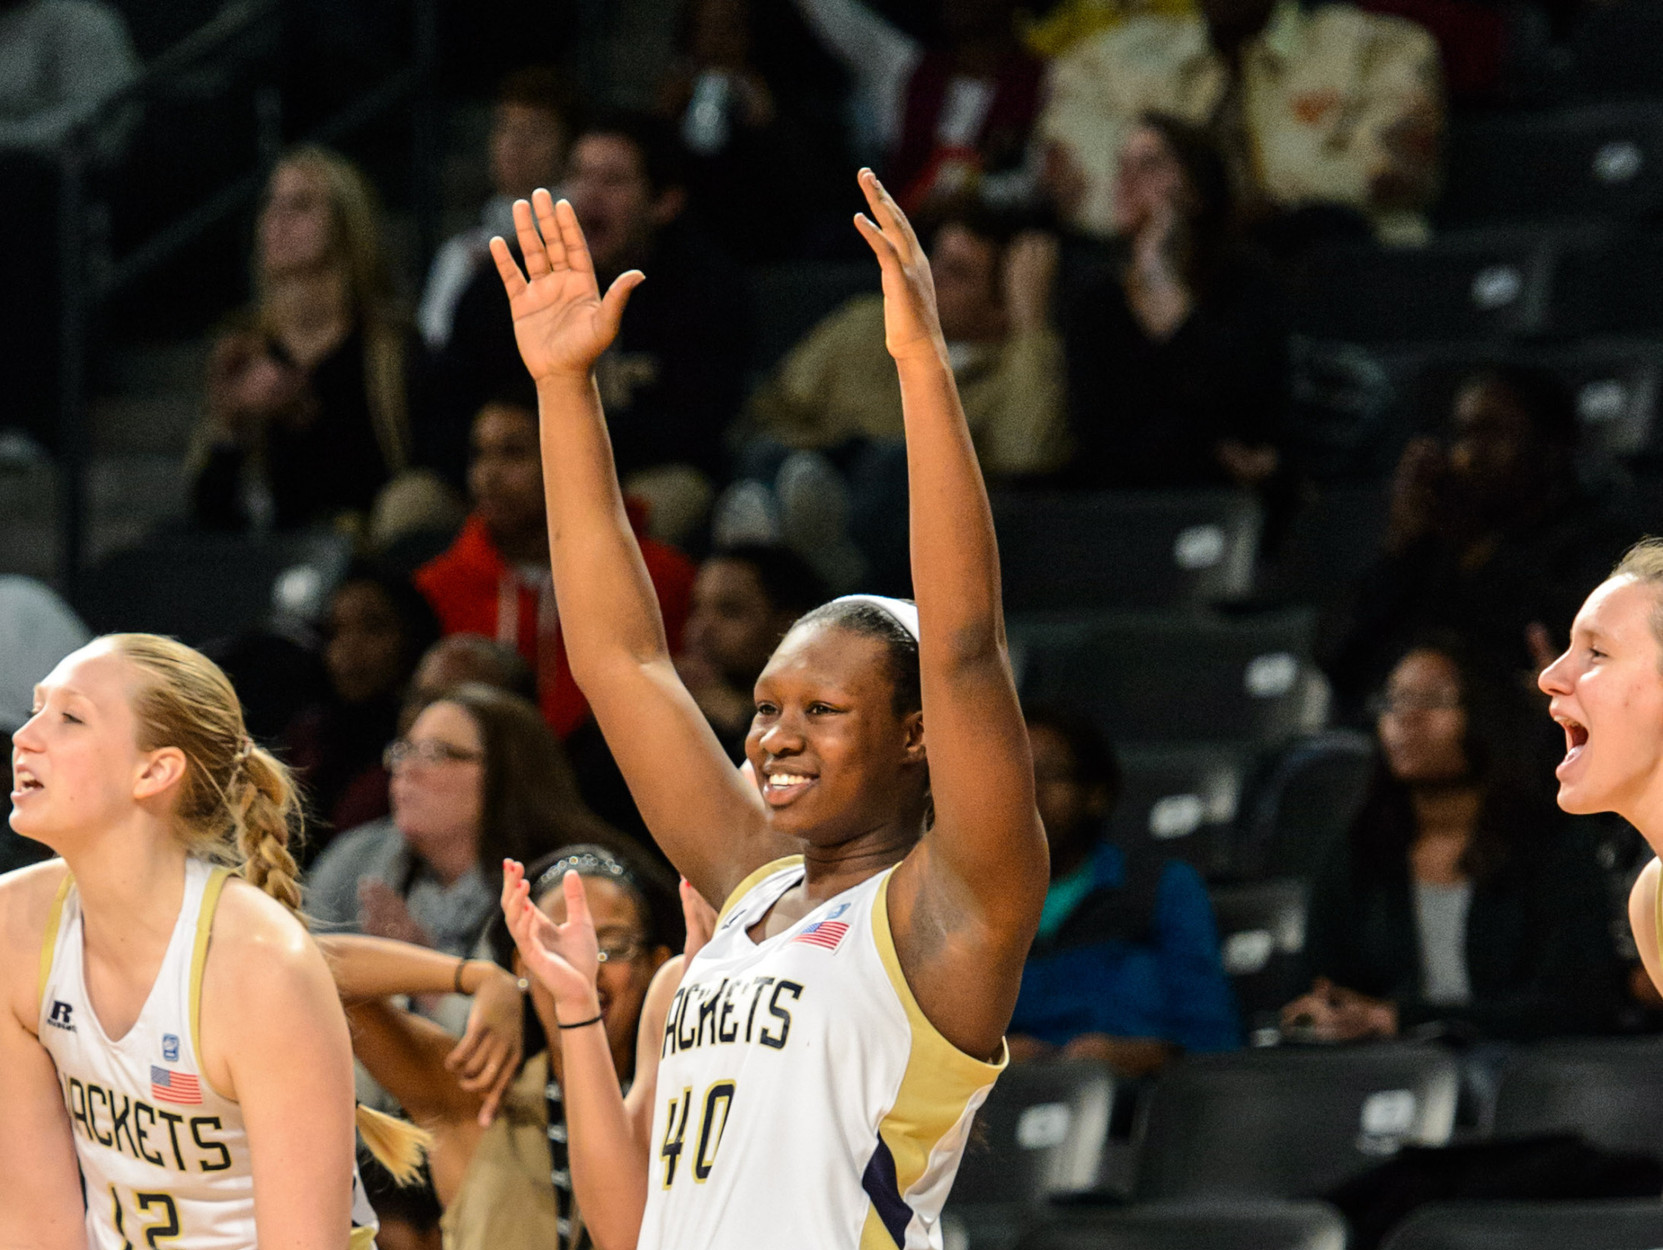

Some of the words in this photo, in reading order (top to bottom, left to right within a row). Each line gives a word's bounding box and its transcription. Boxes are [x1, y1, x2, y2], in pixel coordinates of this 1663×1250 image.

[660, 977, 805, 1060] ACKETS
[65, 1074, 232, 1172] ACKETS
[660, 1079, 737, 1190] 40
